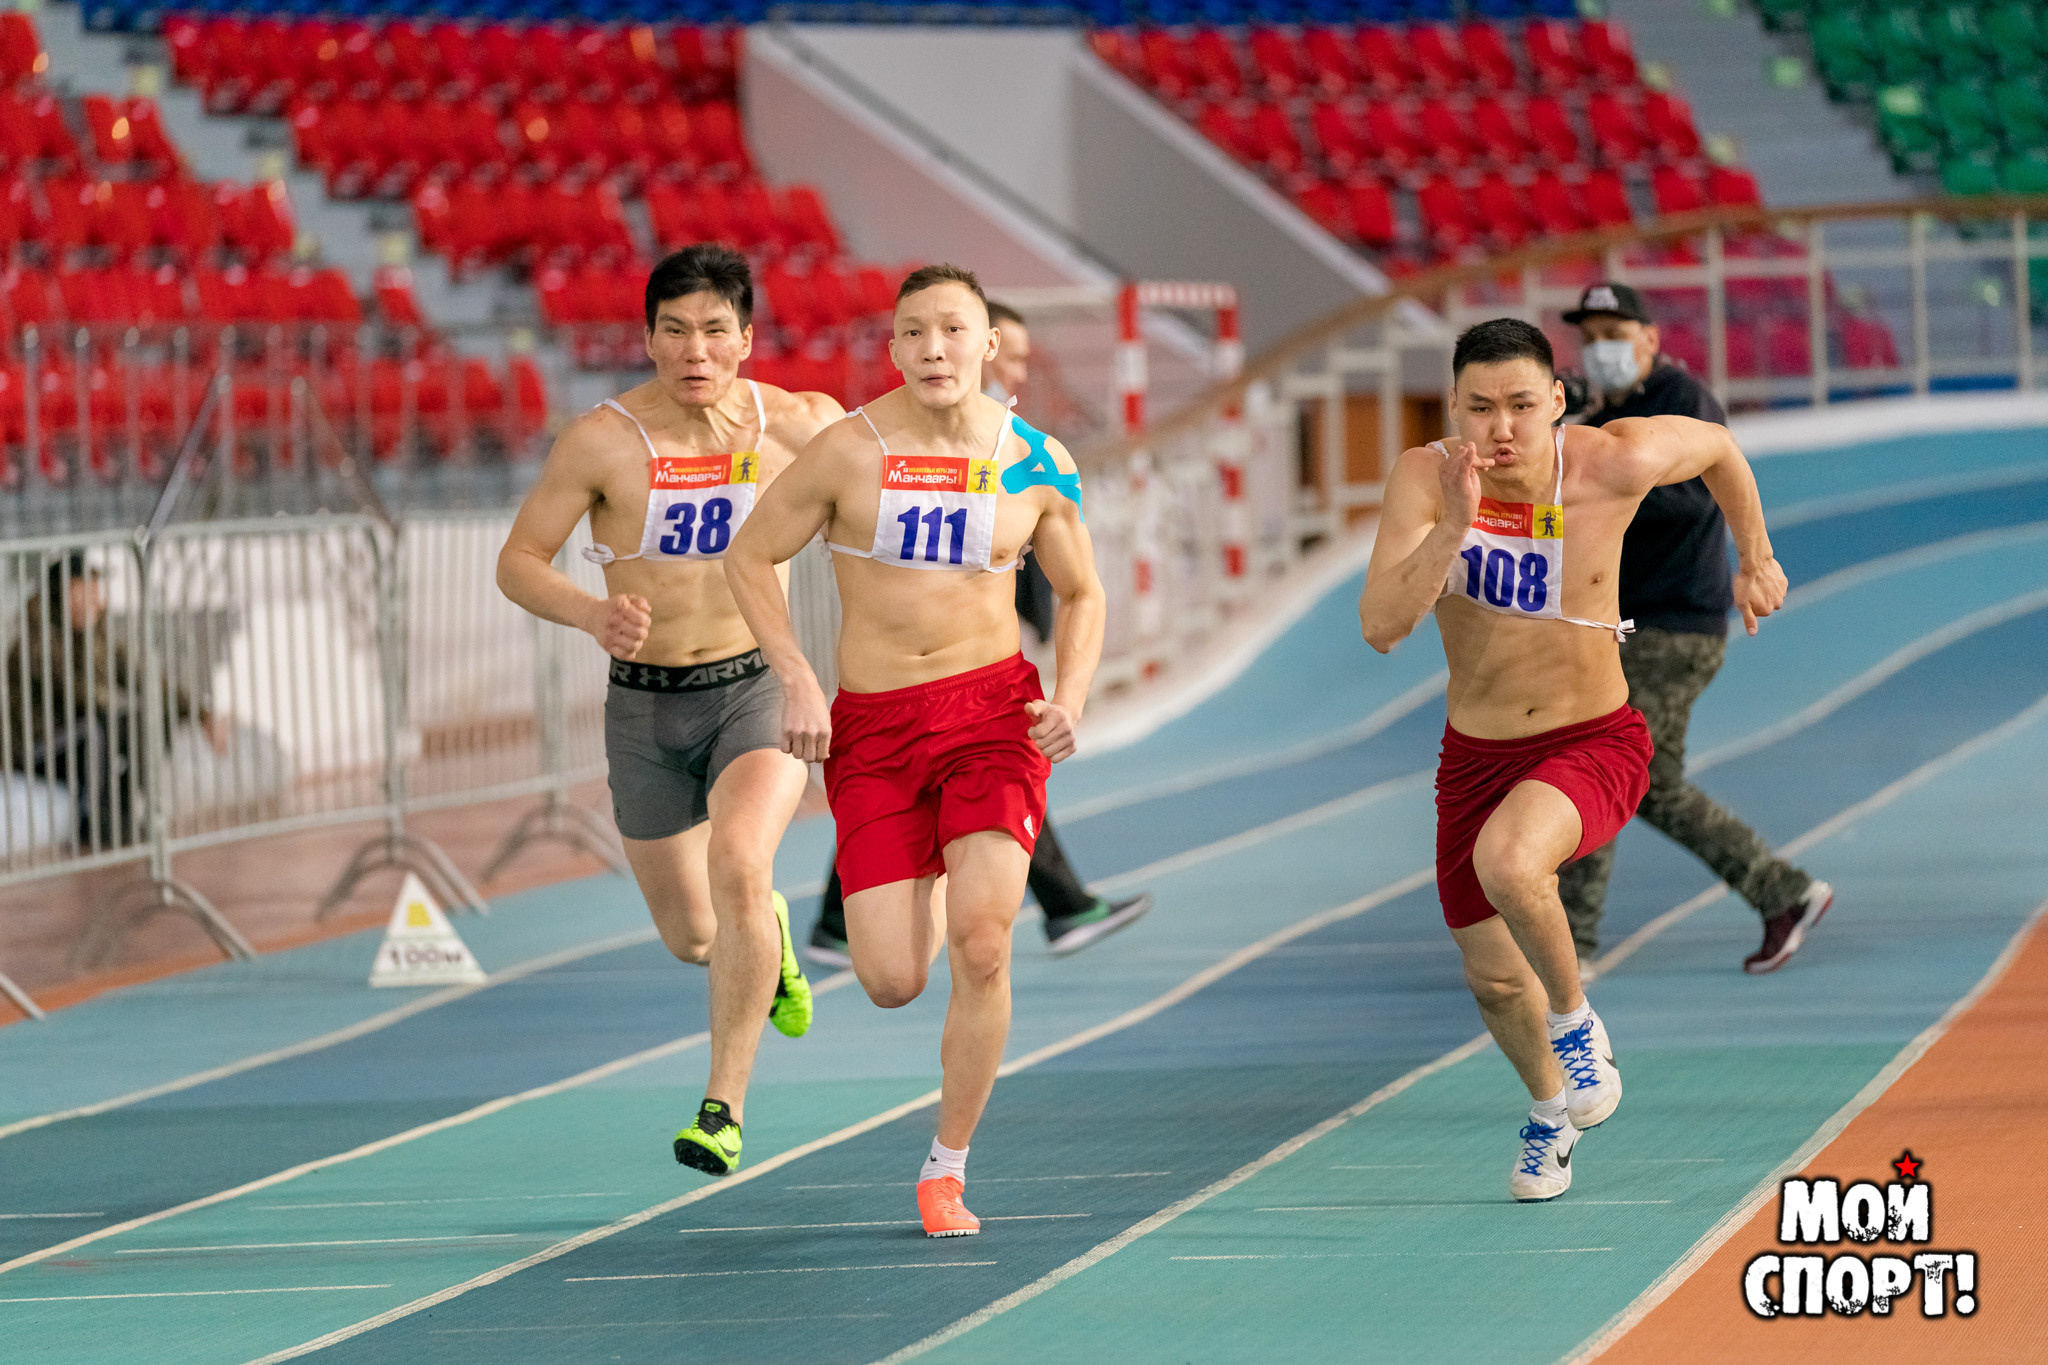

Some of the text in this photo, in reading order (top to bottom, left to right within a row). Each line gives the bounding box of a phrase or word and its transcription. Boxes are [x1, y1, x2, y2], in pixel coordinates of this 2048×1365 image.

[655, 470, 722, 483] Манчаары
[888, 469, 957, 484] Манчаары
[659, 497, 733, 555] 38
[897, 505, 968, 565] 111
[1475, 515, 1523, 530] нчаары
[1460, 544, 1548, 612] 108
[676, 651, 764, 688] ARM
